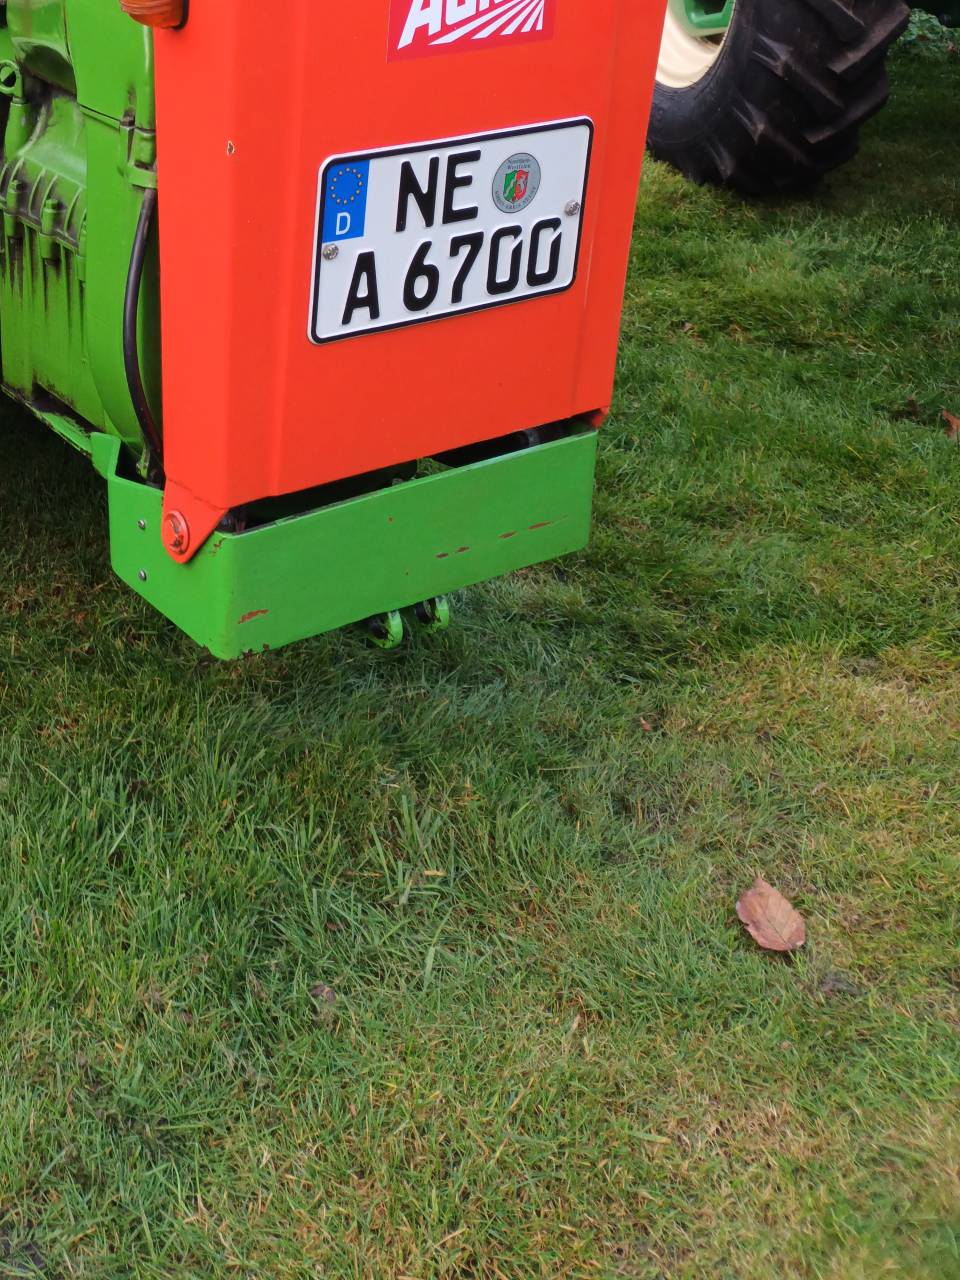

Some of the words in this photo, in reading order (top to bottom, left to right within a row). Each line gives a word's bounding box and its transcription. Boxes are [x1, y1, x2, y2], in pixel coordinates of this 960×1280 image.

[334, 212, 351, 236] D
[395, 149, 482, 233] NE
[341, 250, 381, 325] A
[402, 217, 562, 312] 6700
